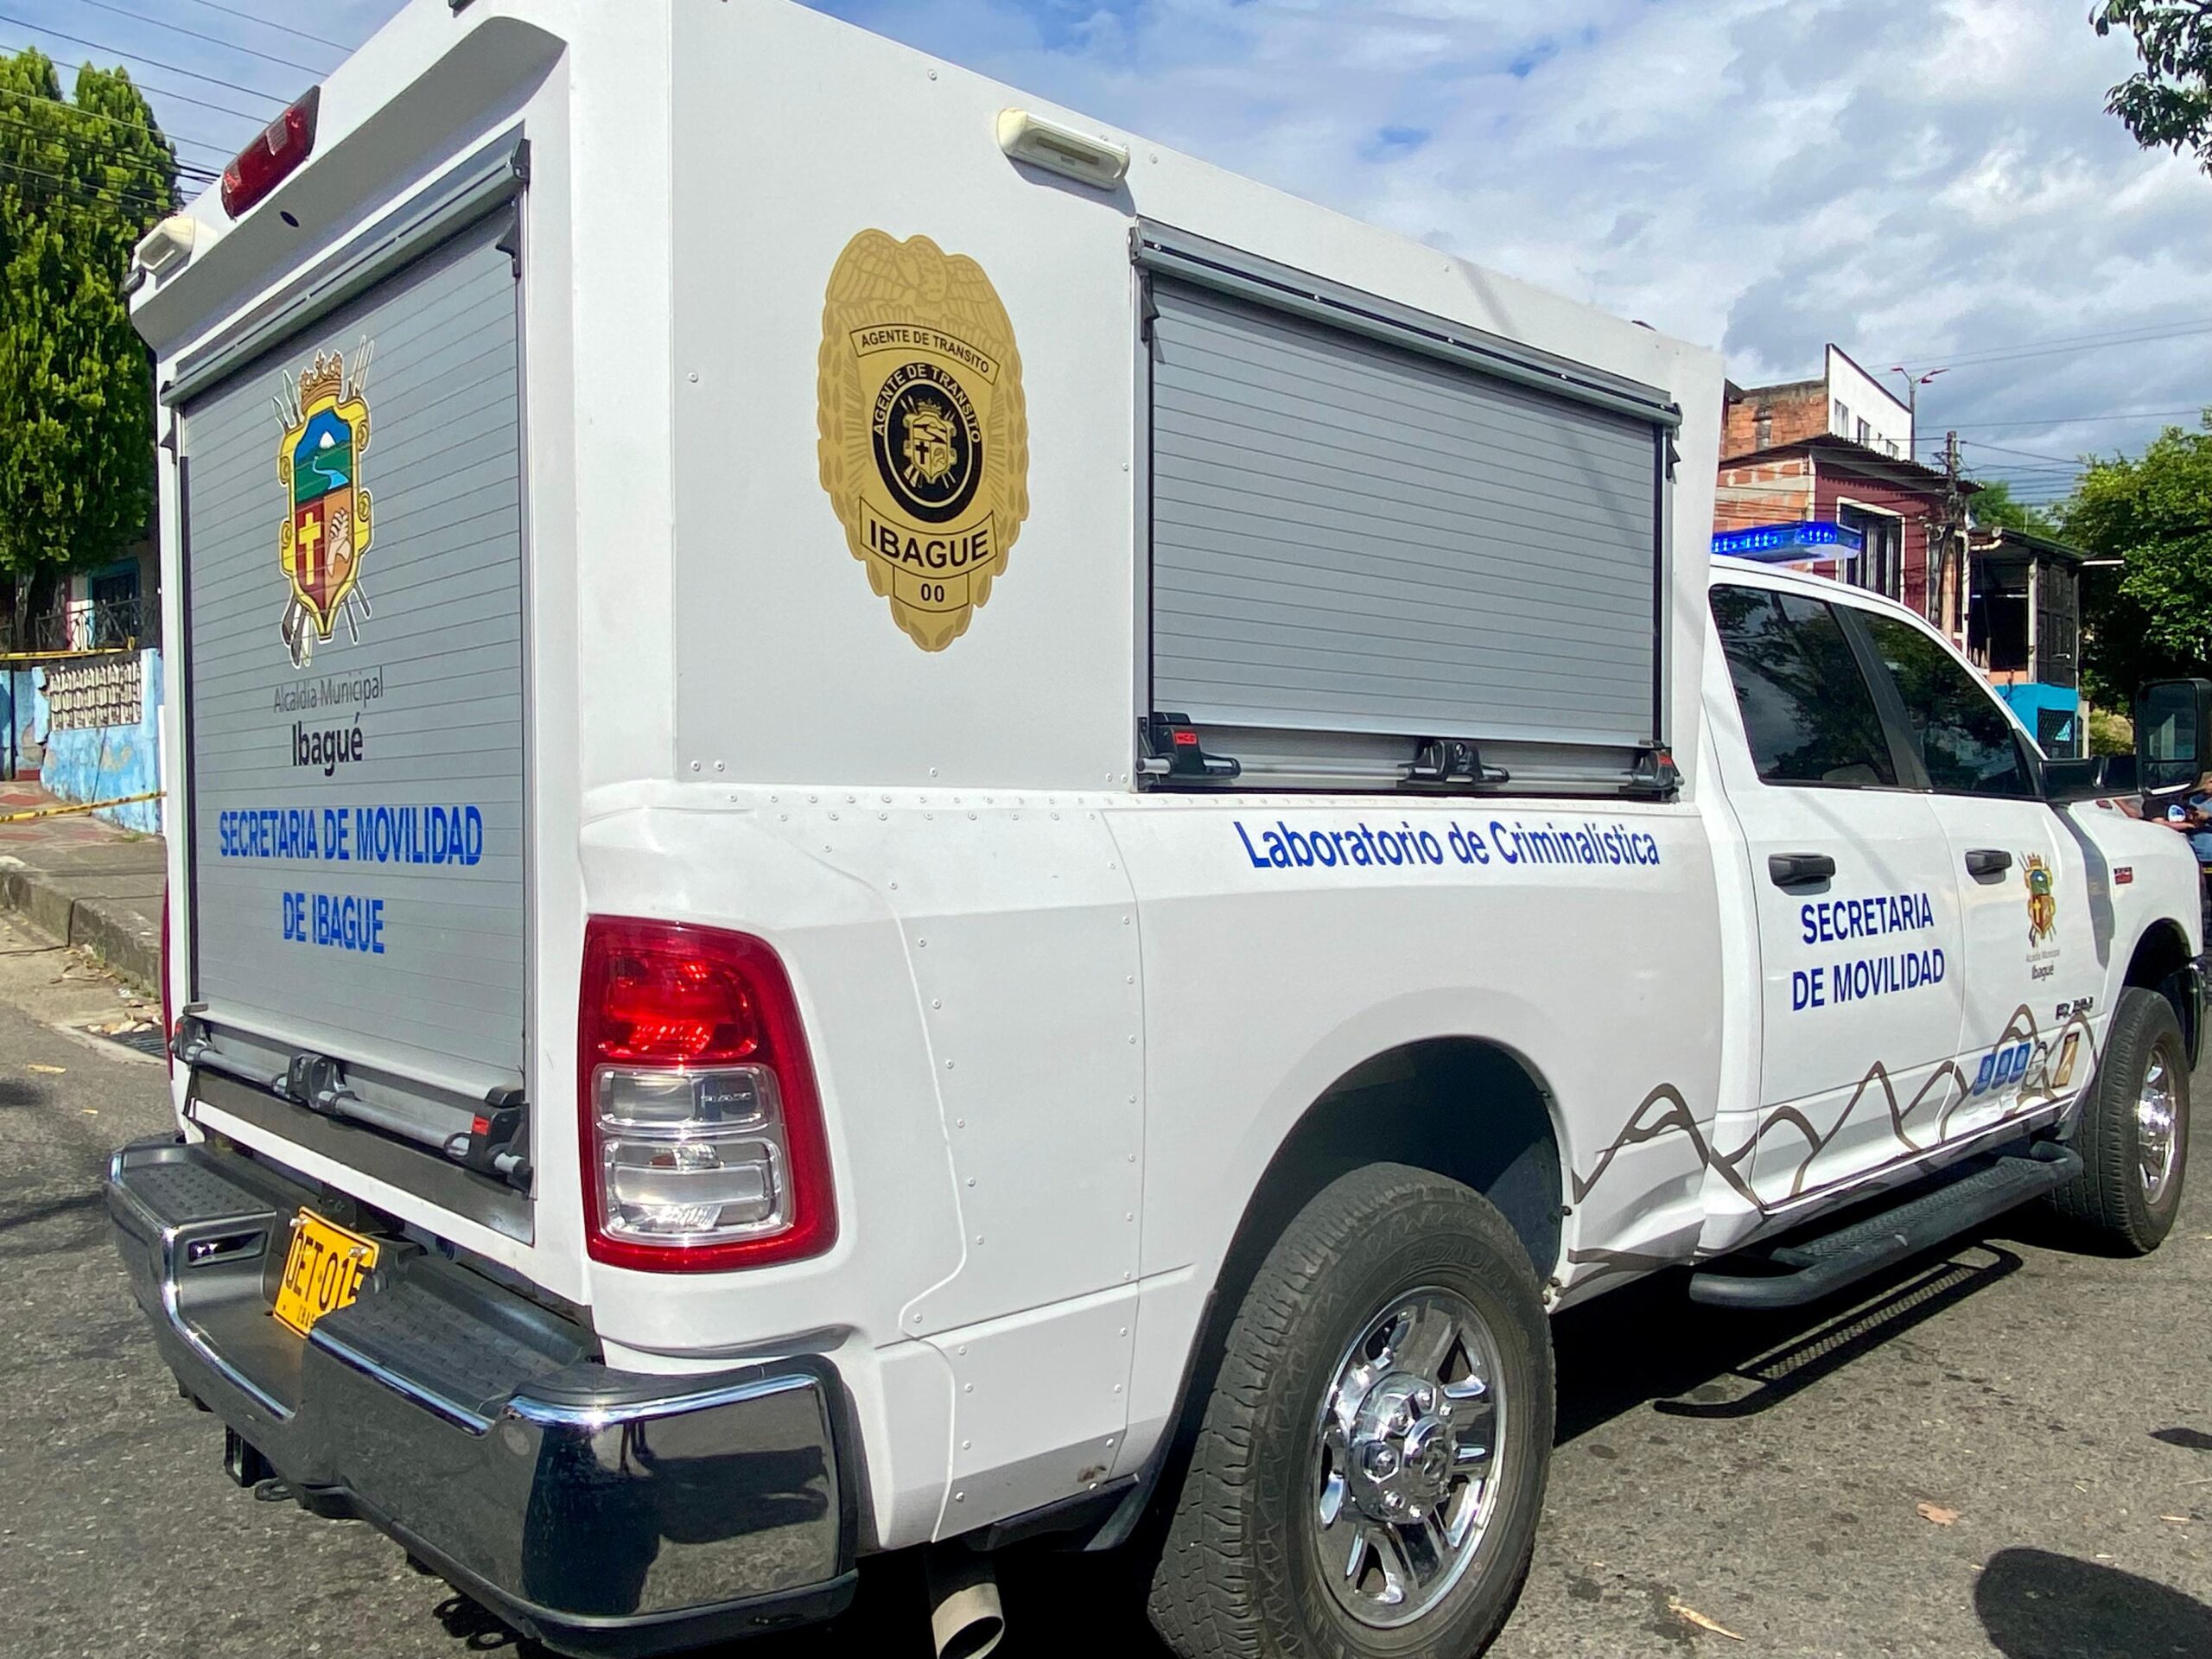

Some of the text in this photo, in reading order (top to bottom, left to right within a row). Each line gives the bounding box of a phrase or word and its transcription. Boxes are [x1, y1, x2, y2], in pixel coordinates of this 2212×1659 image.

[861, 329, 989, 373] AGENTE DE TRANSITO
[874, 363, 982, 443] AGENTE DE TRANSITO
[870, 518, 988, 569] IBAGUE
[920, 582, 945, 603] 00
[321, 666, 384, 709] Municipal
[292, 711, 363, 777] Ibagué
[219, 804, 483, 866] SECRETARIA DE MOVILIDAD
[1234, 821, 1660, 869] Laboratorio de Criminalística
[283, 892, 385, 955] DE IBAGUE
[1801, 893, 1934, 944] SECRETARIA
[1792, 948, 1945, 1012] DE MOVILIDAD
